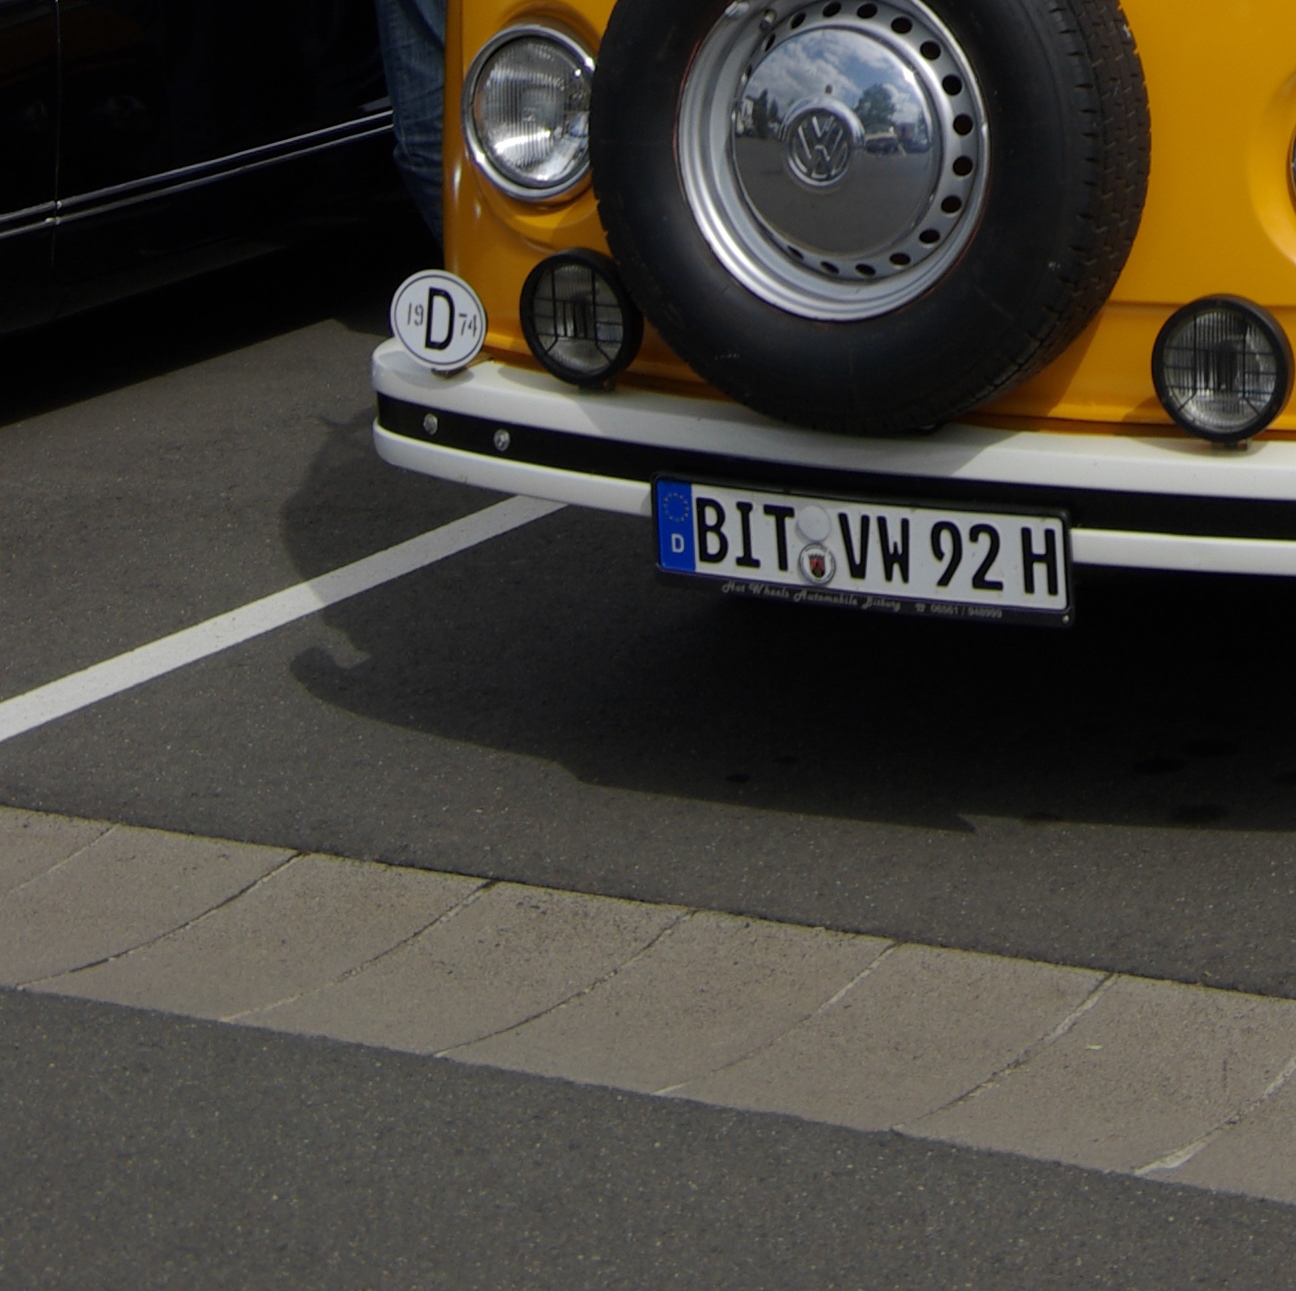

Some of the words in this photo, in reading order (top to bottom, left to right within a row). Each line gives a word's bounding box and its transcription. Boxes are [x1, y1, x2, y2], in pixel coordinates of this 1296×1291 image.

[424, 286, 456, 351] D
[671, 532, 685, 554] D
[695, 496, 795, 572] BIT
[837, 511, 911, 584] VW
[748, 582, 790, 598] Wheels
